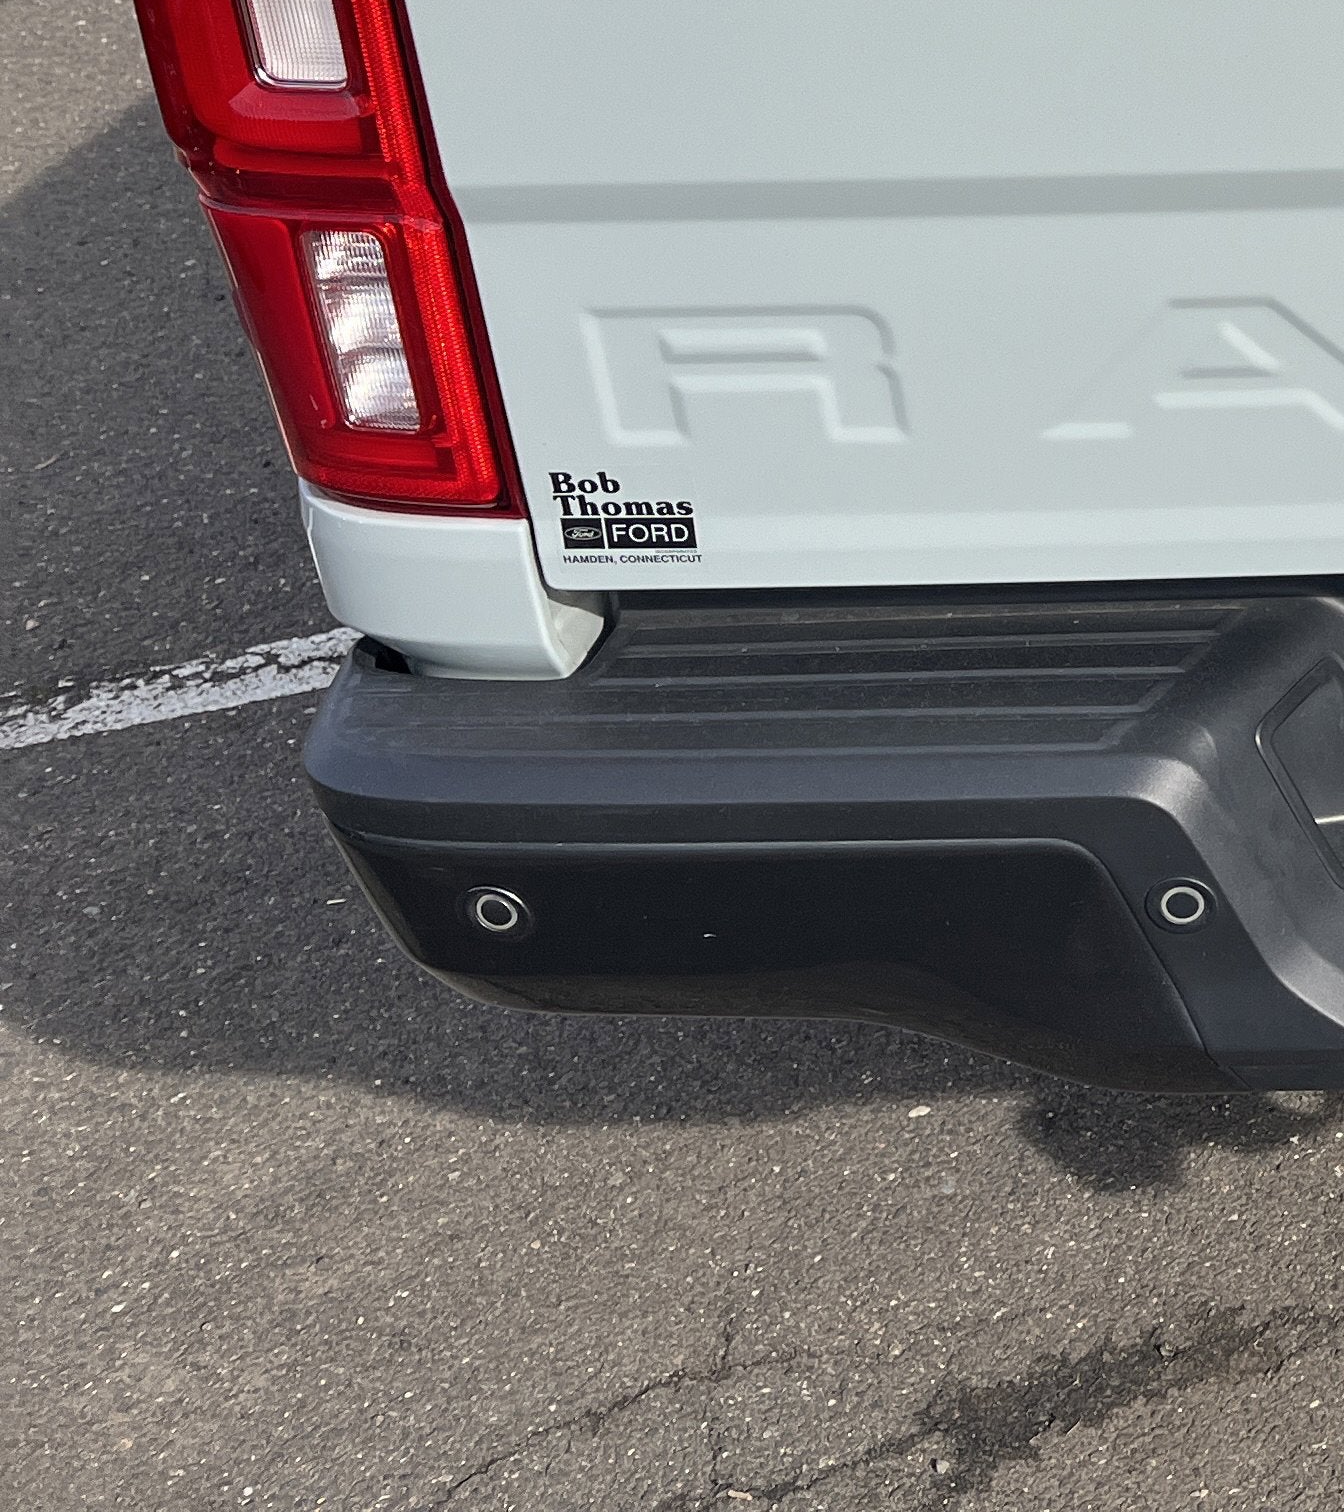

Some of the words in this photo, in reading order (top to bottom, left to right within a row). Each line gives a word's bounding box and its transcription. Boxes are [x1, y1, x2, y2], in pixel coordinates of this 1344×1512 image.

[548, 471, 621, 494] Bob
[552, 494, 694, 516] Thomas
[611, 523, 689, 542] FORD
[562, 554, 618, 565] HAMDEN,
[619, 553, 703, 564] CONNECTICUT
